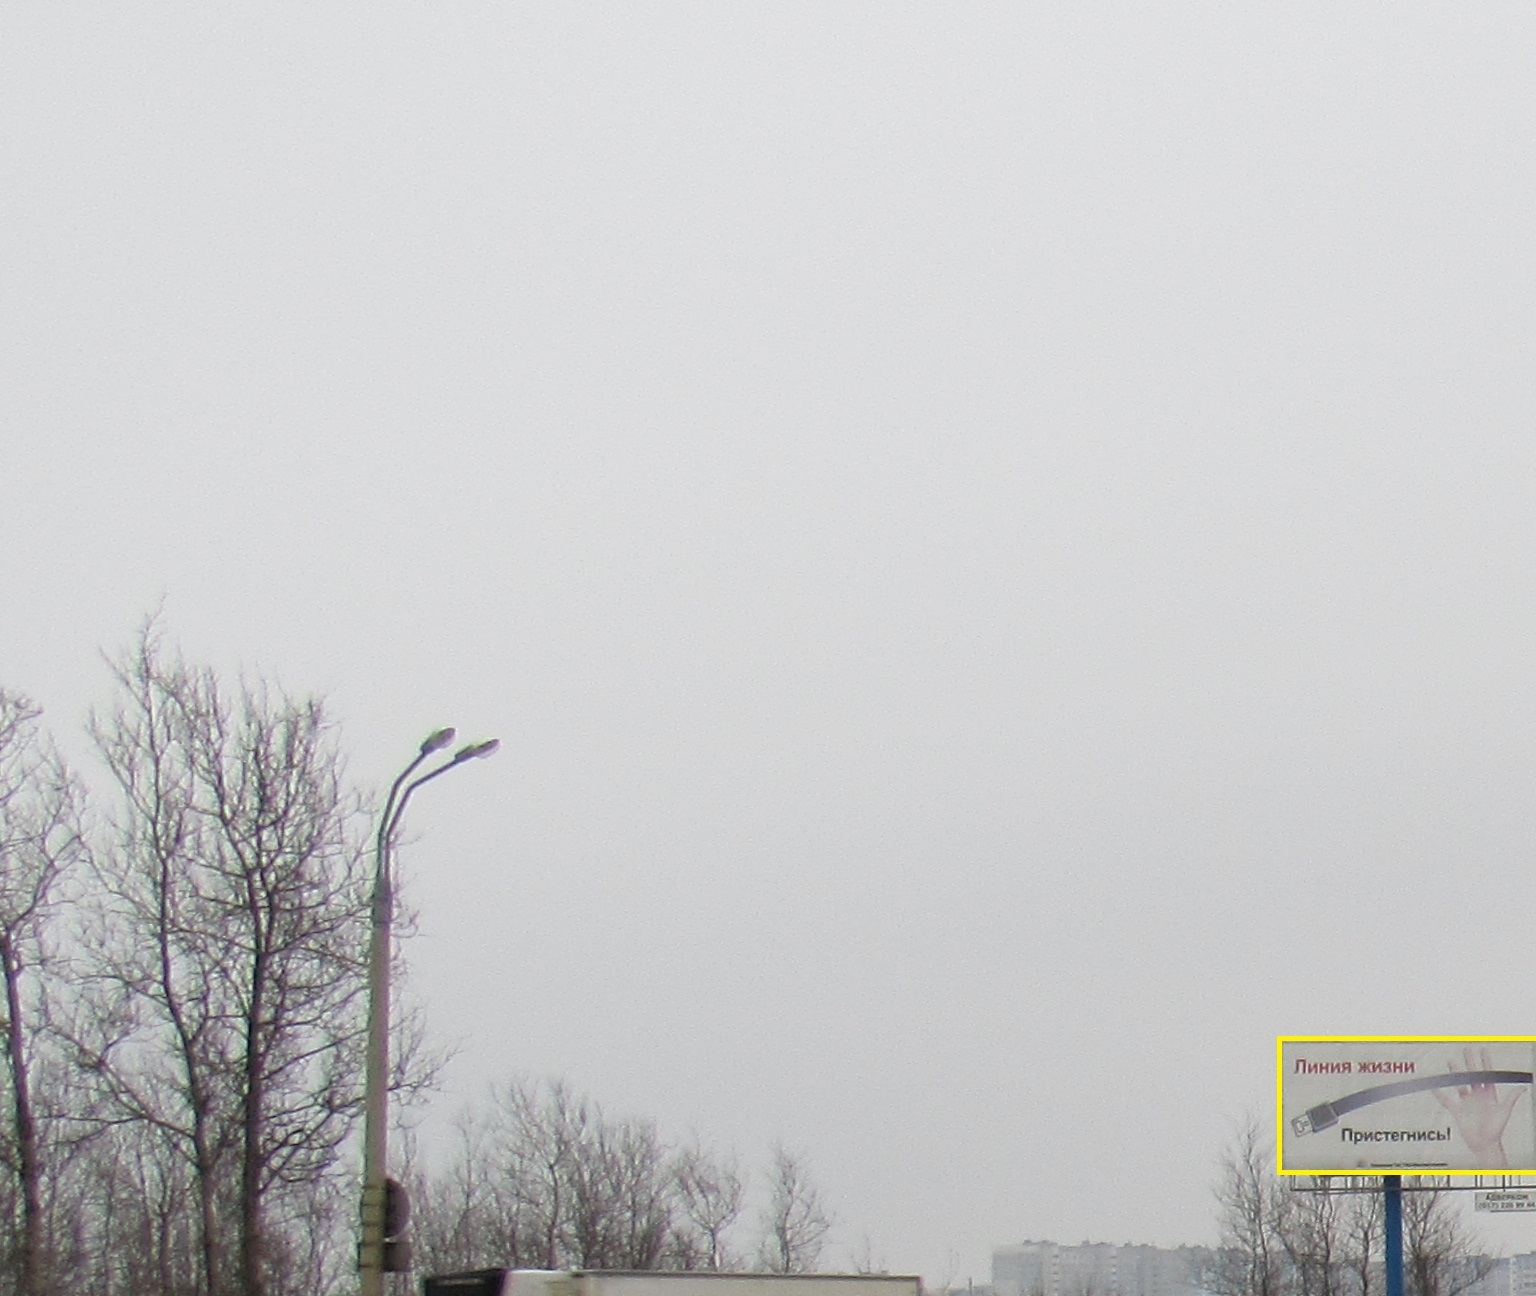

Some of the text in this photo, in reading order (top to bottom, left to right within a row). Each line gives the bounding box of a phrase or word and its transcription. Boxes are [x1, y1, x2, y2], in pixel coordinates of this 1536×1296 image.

[1294, 1059, 1415, 1074] Линия жизни
[1341, 1127, 1451, 1144] Пристегнись!
